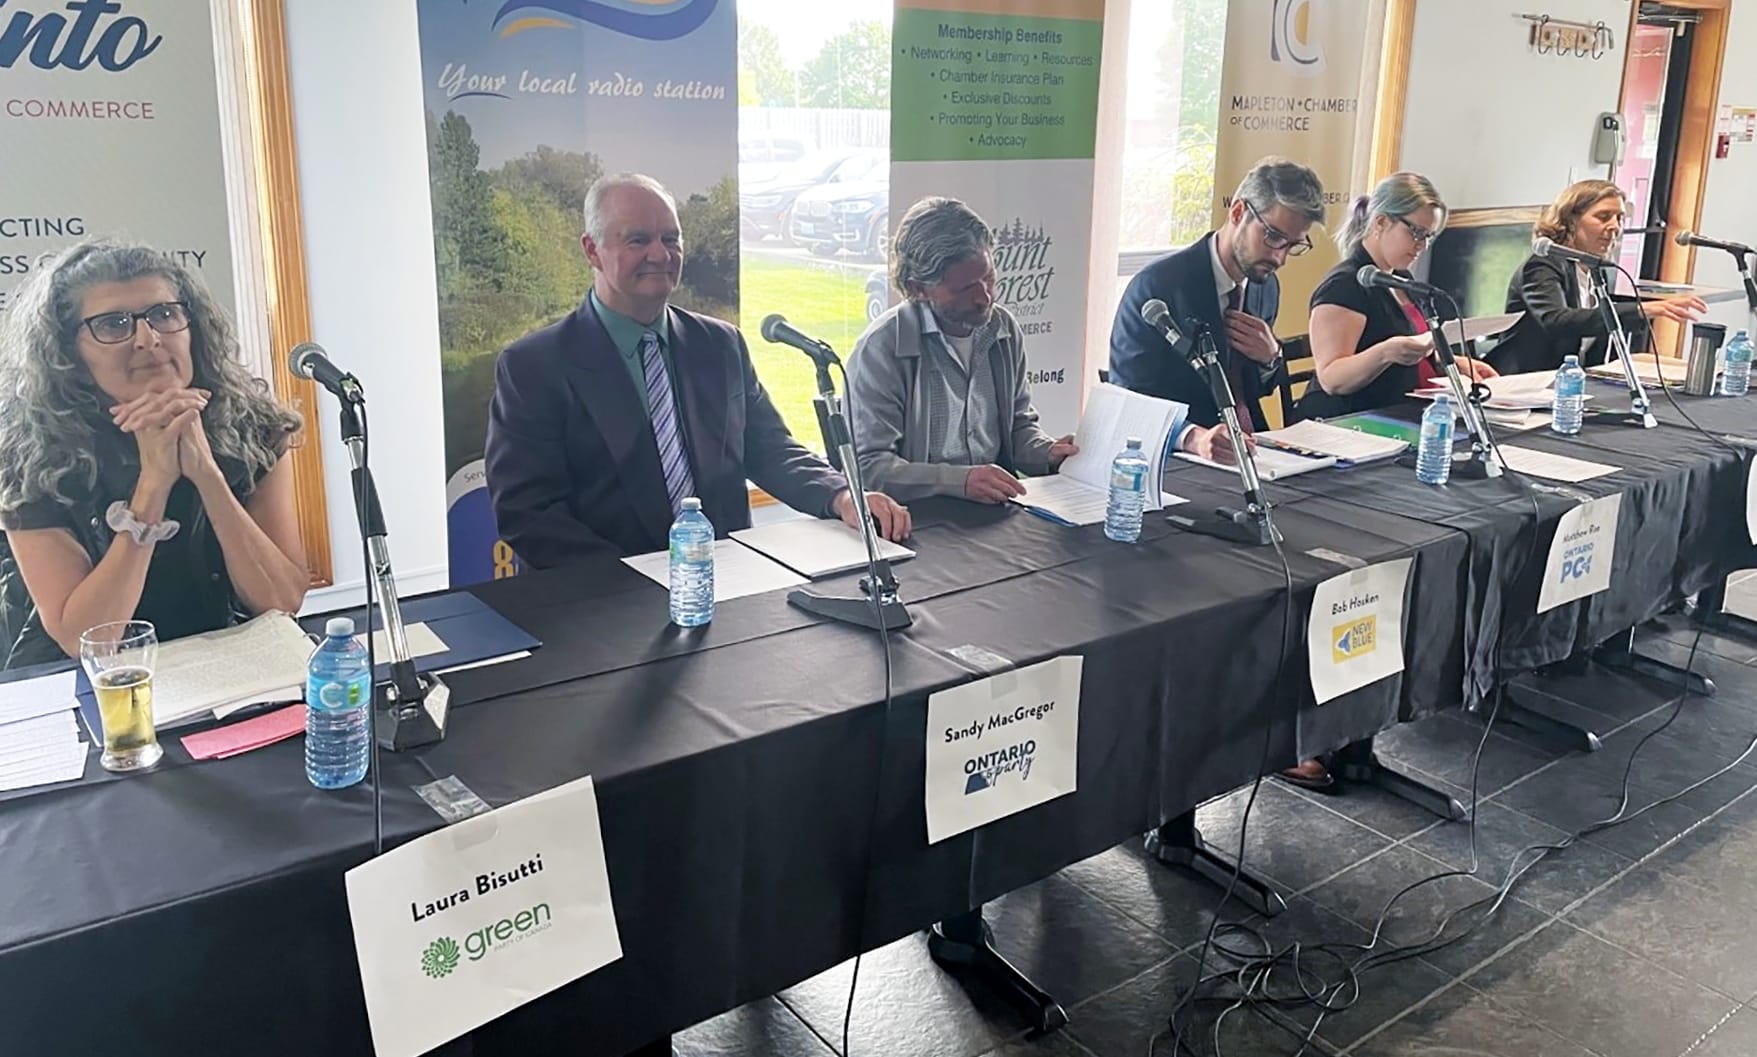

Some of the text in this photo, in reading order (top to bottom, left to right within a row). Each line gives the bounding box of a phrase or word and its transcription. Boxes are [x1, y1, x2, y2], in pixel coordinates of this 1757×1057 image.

[938, 24, 1063, 45] Membership Benefits
[911, 46, 1094, 66] Networking Learning Resources
[438, 62, 725, 99] Your local radio station
[939, 69, 1064, 86] Chamber Insurance Plan
[952, 91, 1052, 105] Exclusive Discounts
[1232, 96, 1358, 112] MAPLETON CHAMBER
[6, 100, 155, 119] COMMERCE
[939, 113, 1065, 128] Promoting Your Business
[1244, 117, 1310, 131] COMMERCE
[977, 134, 1026, 148] Advocacy
[1564, 543, 1594, 558] ONTARIO
[1560, 556, 1585, 584] PC
[1332, 602, 1347, 615] Bob
[1353, 622, 1373, 634] NEW
[1353, 633, 1372, 648] BLUE
[945, 701, 1055, 743] Sandy MacGregor
[964, 740, 1036, 774] ONTARIO
[990, 750, 1034, 786] party
[411, 853, 544, 922] Laura Bisutti
[464, 902, 552, 961] green
